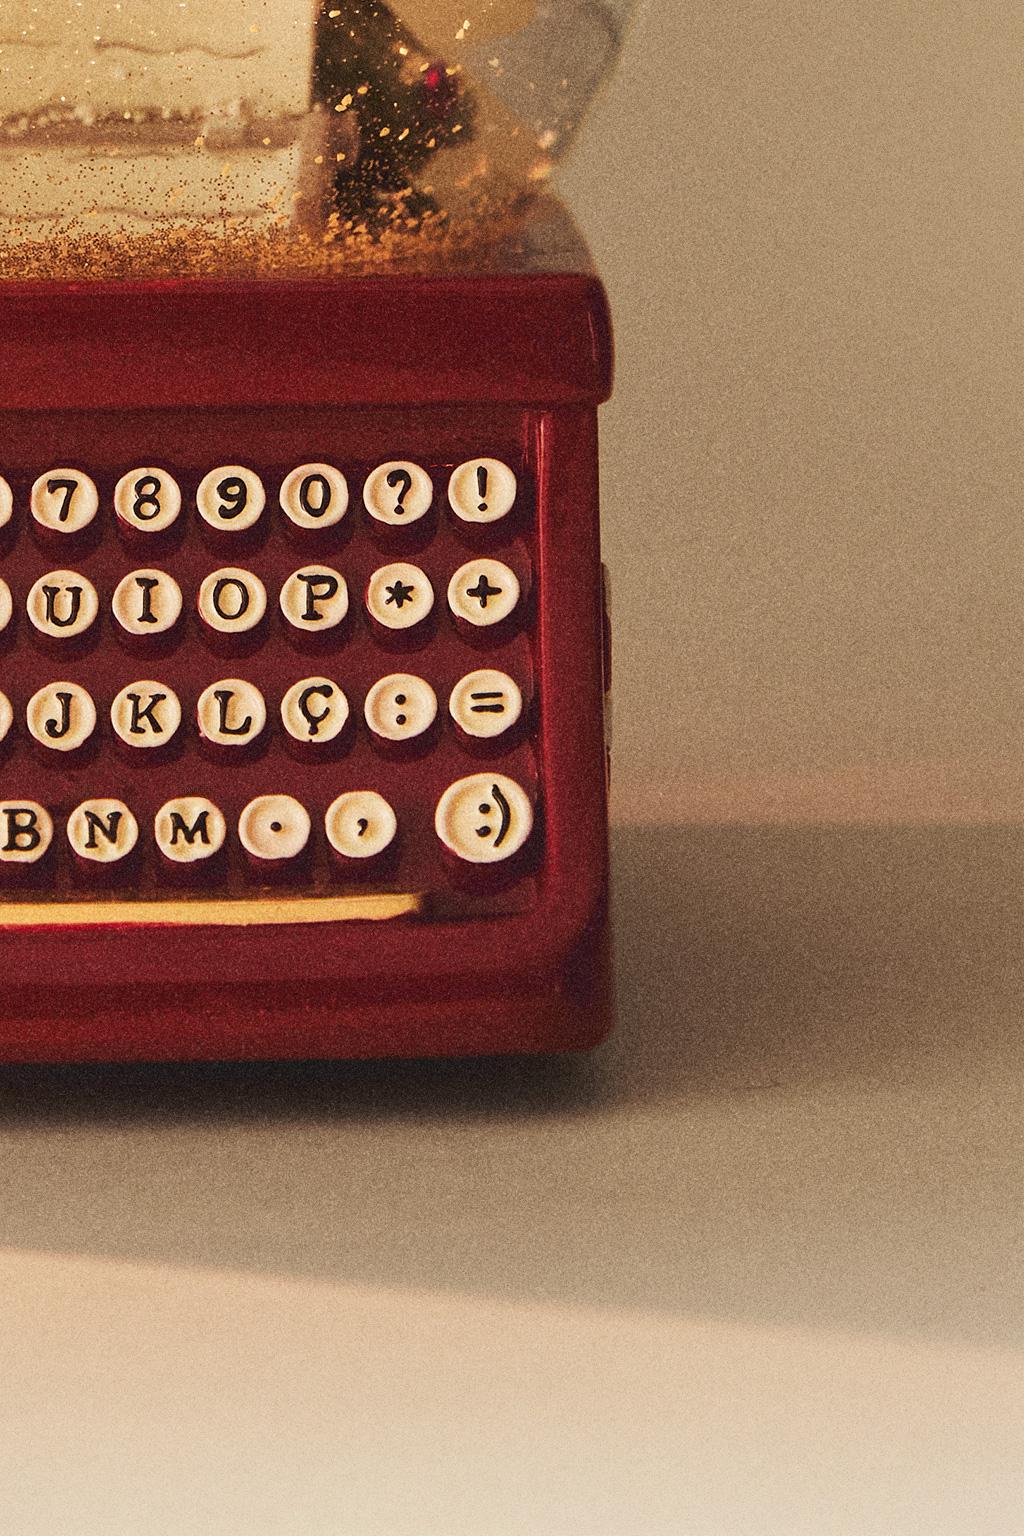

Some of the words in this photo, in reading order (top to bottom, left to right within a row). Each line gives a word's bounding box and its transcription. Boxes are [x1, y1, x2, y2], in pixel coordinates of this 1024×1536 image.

[45, 477, 80, 523] 7
[132, 474, 163, 522] 8
[215, 475, 249, 521] 9
[298, 472, 333, 519] 0
[385, 467, 414, 516] ?
[475, 464, 490, 513] !
[40, 583, 84, 629] U
[134, 576, 160, 625] I
[211, 576, 251, 621] O
[295, 573, 340, 623] P
[465, 573, 504, 610] +
[44, 690, 75, 740] J
[125, 691, 168, 736] K
[212, 689, 254, 737] L
[297, 683, 335, 737] Ç
[470, 690, 506, 715] =
[1, 807, 43, 853] B
[83, 809, 124, 850] N
[169, 809, 212, 847] M
